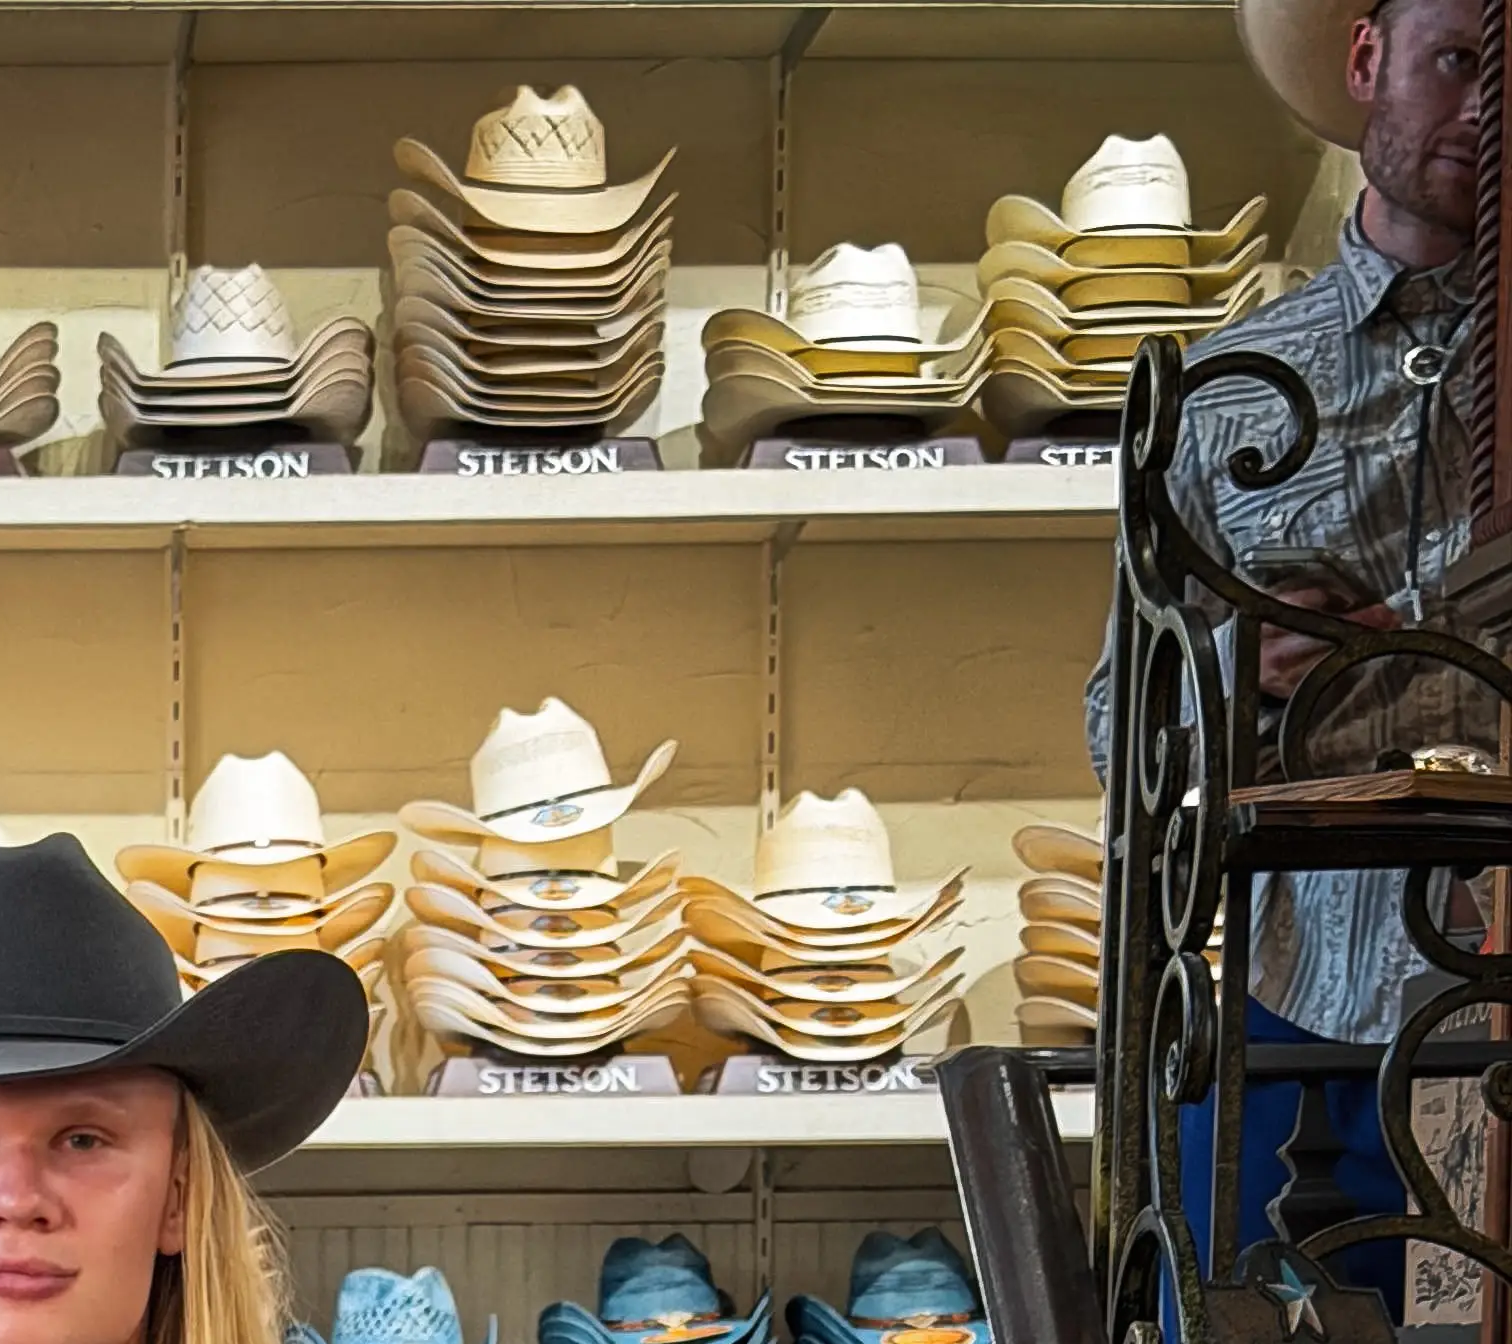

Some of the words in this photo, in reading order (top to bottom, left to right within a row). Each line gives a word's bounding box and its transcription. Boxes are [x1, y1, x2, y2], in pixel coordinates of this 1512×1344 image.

[152, 452, 310, 480] STETSON
[458, 446, 621, 475] STETSON
[785, 446, 944, 470] STETSON
[1040, 446, 1121, 466] STET
[477, 1065, 640, 1094] STETSON
